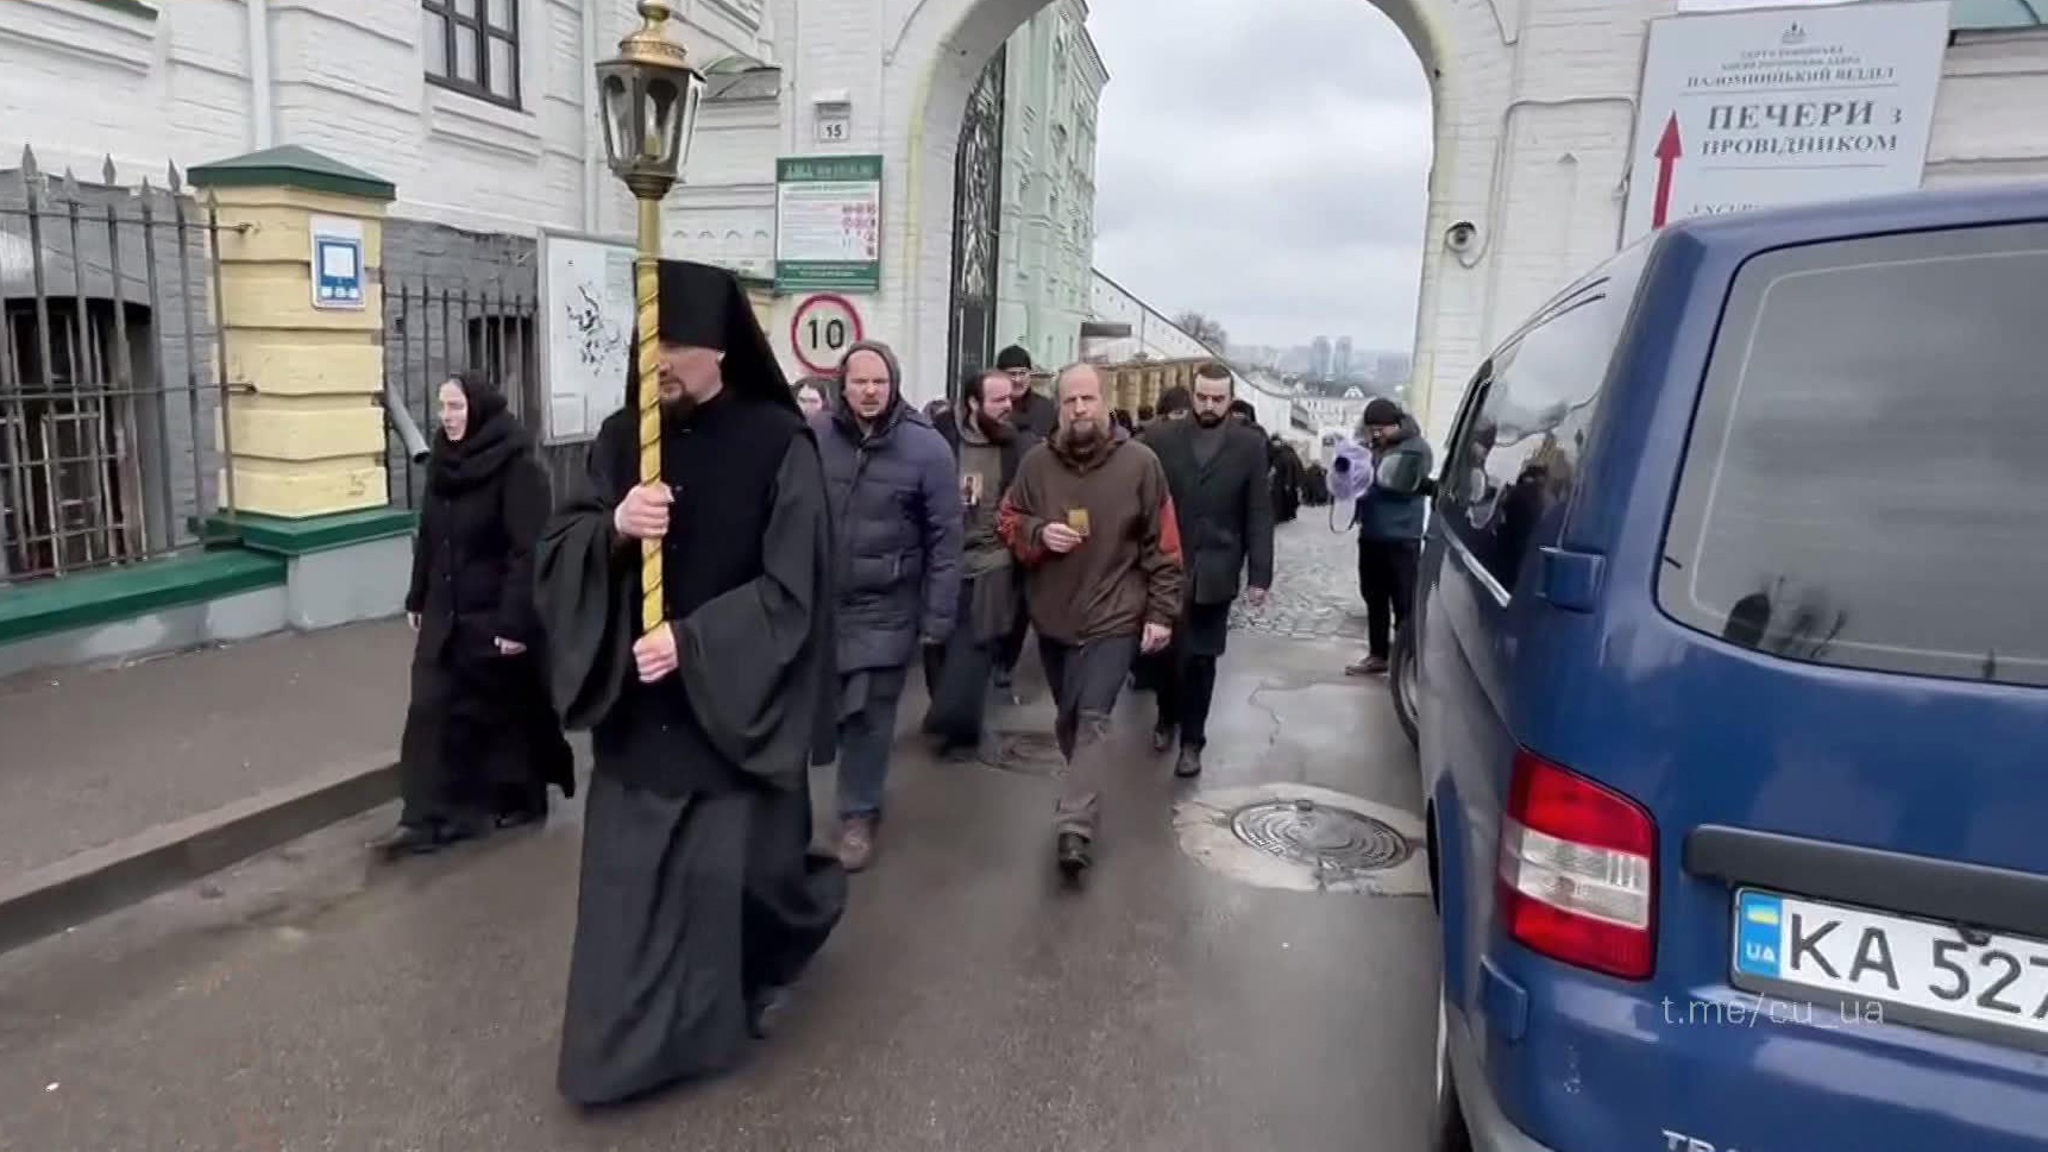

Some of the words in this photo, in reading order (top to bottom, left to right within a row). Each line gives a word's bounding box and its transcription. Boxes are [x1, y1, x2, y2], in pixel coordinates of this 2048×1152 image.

[1706, 101, 1875, 130] ПЕЧЕРИ
[826, 124, 842, 137] 15
[1701, 134, 1898, 156] ПРОВІДНИКОМ
[807, 319, 845, 351] 10
[1746, 942, 1776, 963] UA
